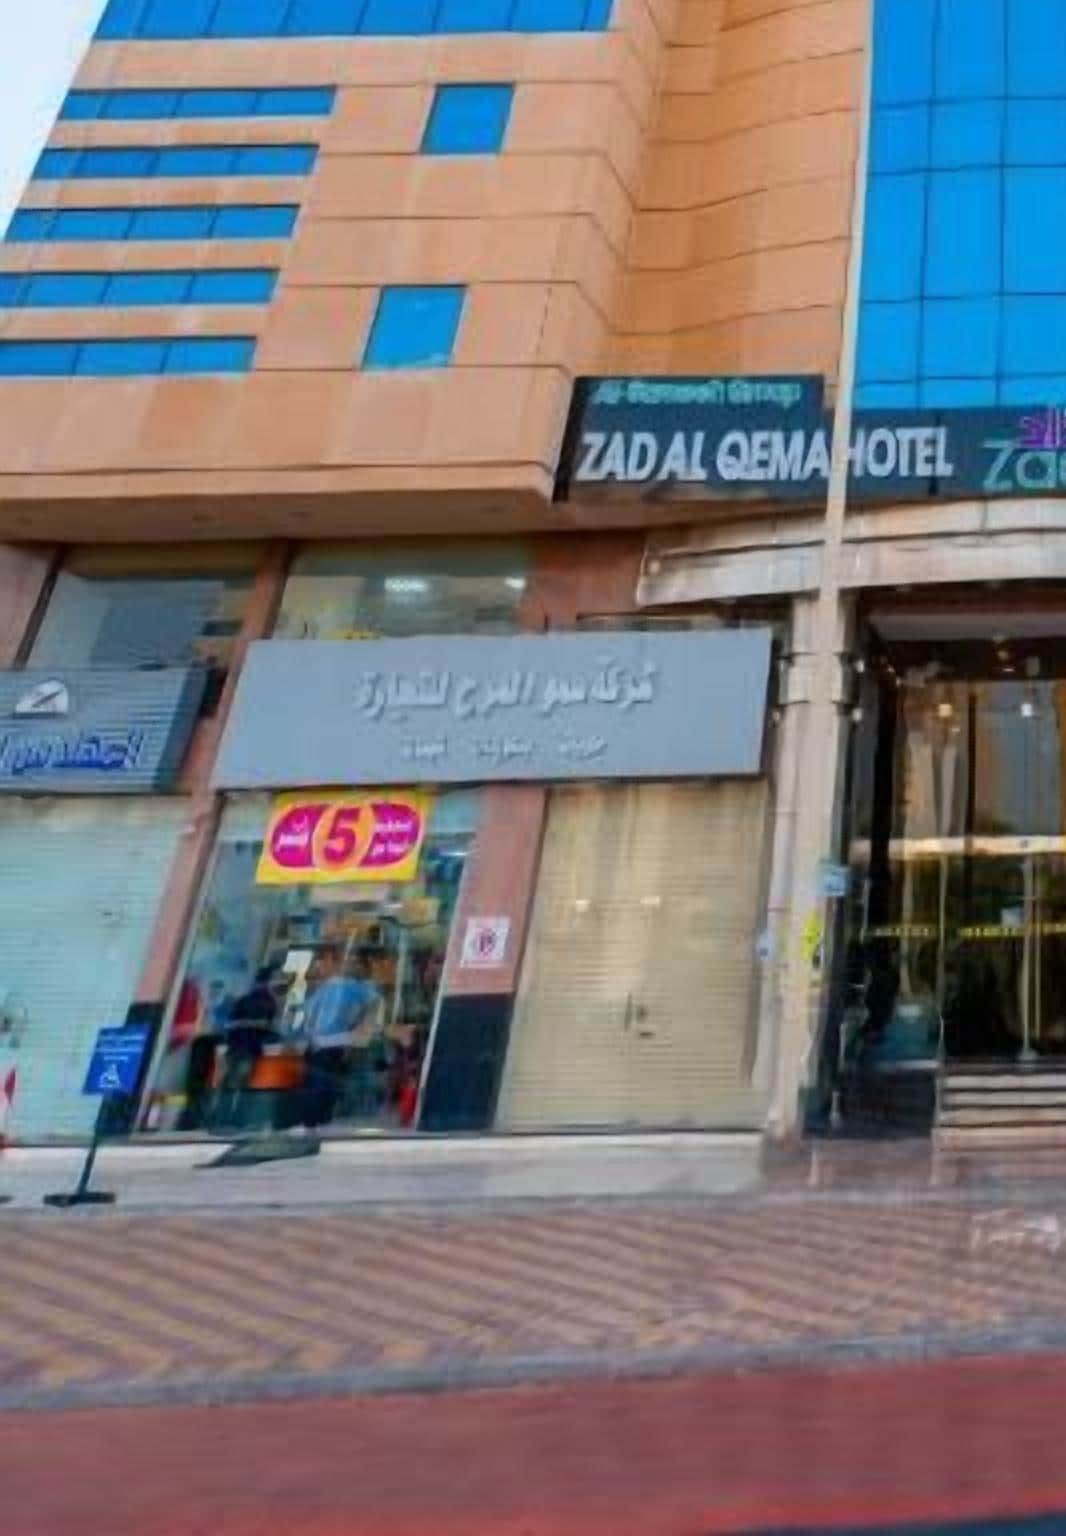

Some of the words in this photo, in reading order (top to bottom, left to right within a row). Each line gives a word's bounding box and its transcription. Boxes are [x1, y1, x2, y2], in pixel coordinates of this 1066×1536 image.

[576, 431, 657, 482] ZAD
[654, 430, 707, 481] AL
[715, 429, 828, 481] QEMA
[844, 426, 953, 478] HOTEL
[323, 806, 361, 865] 5
